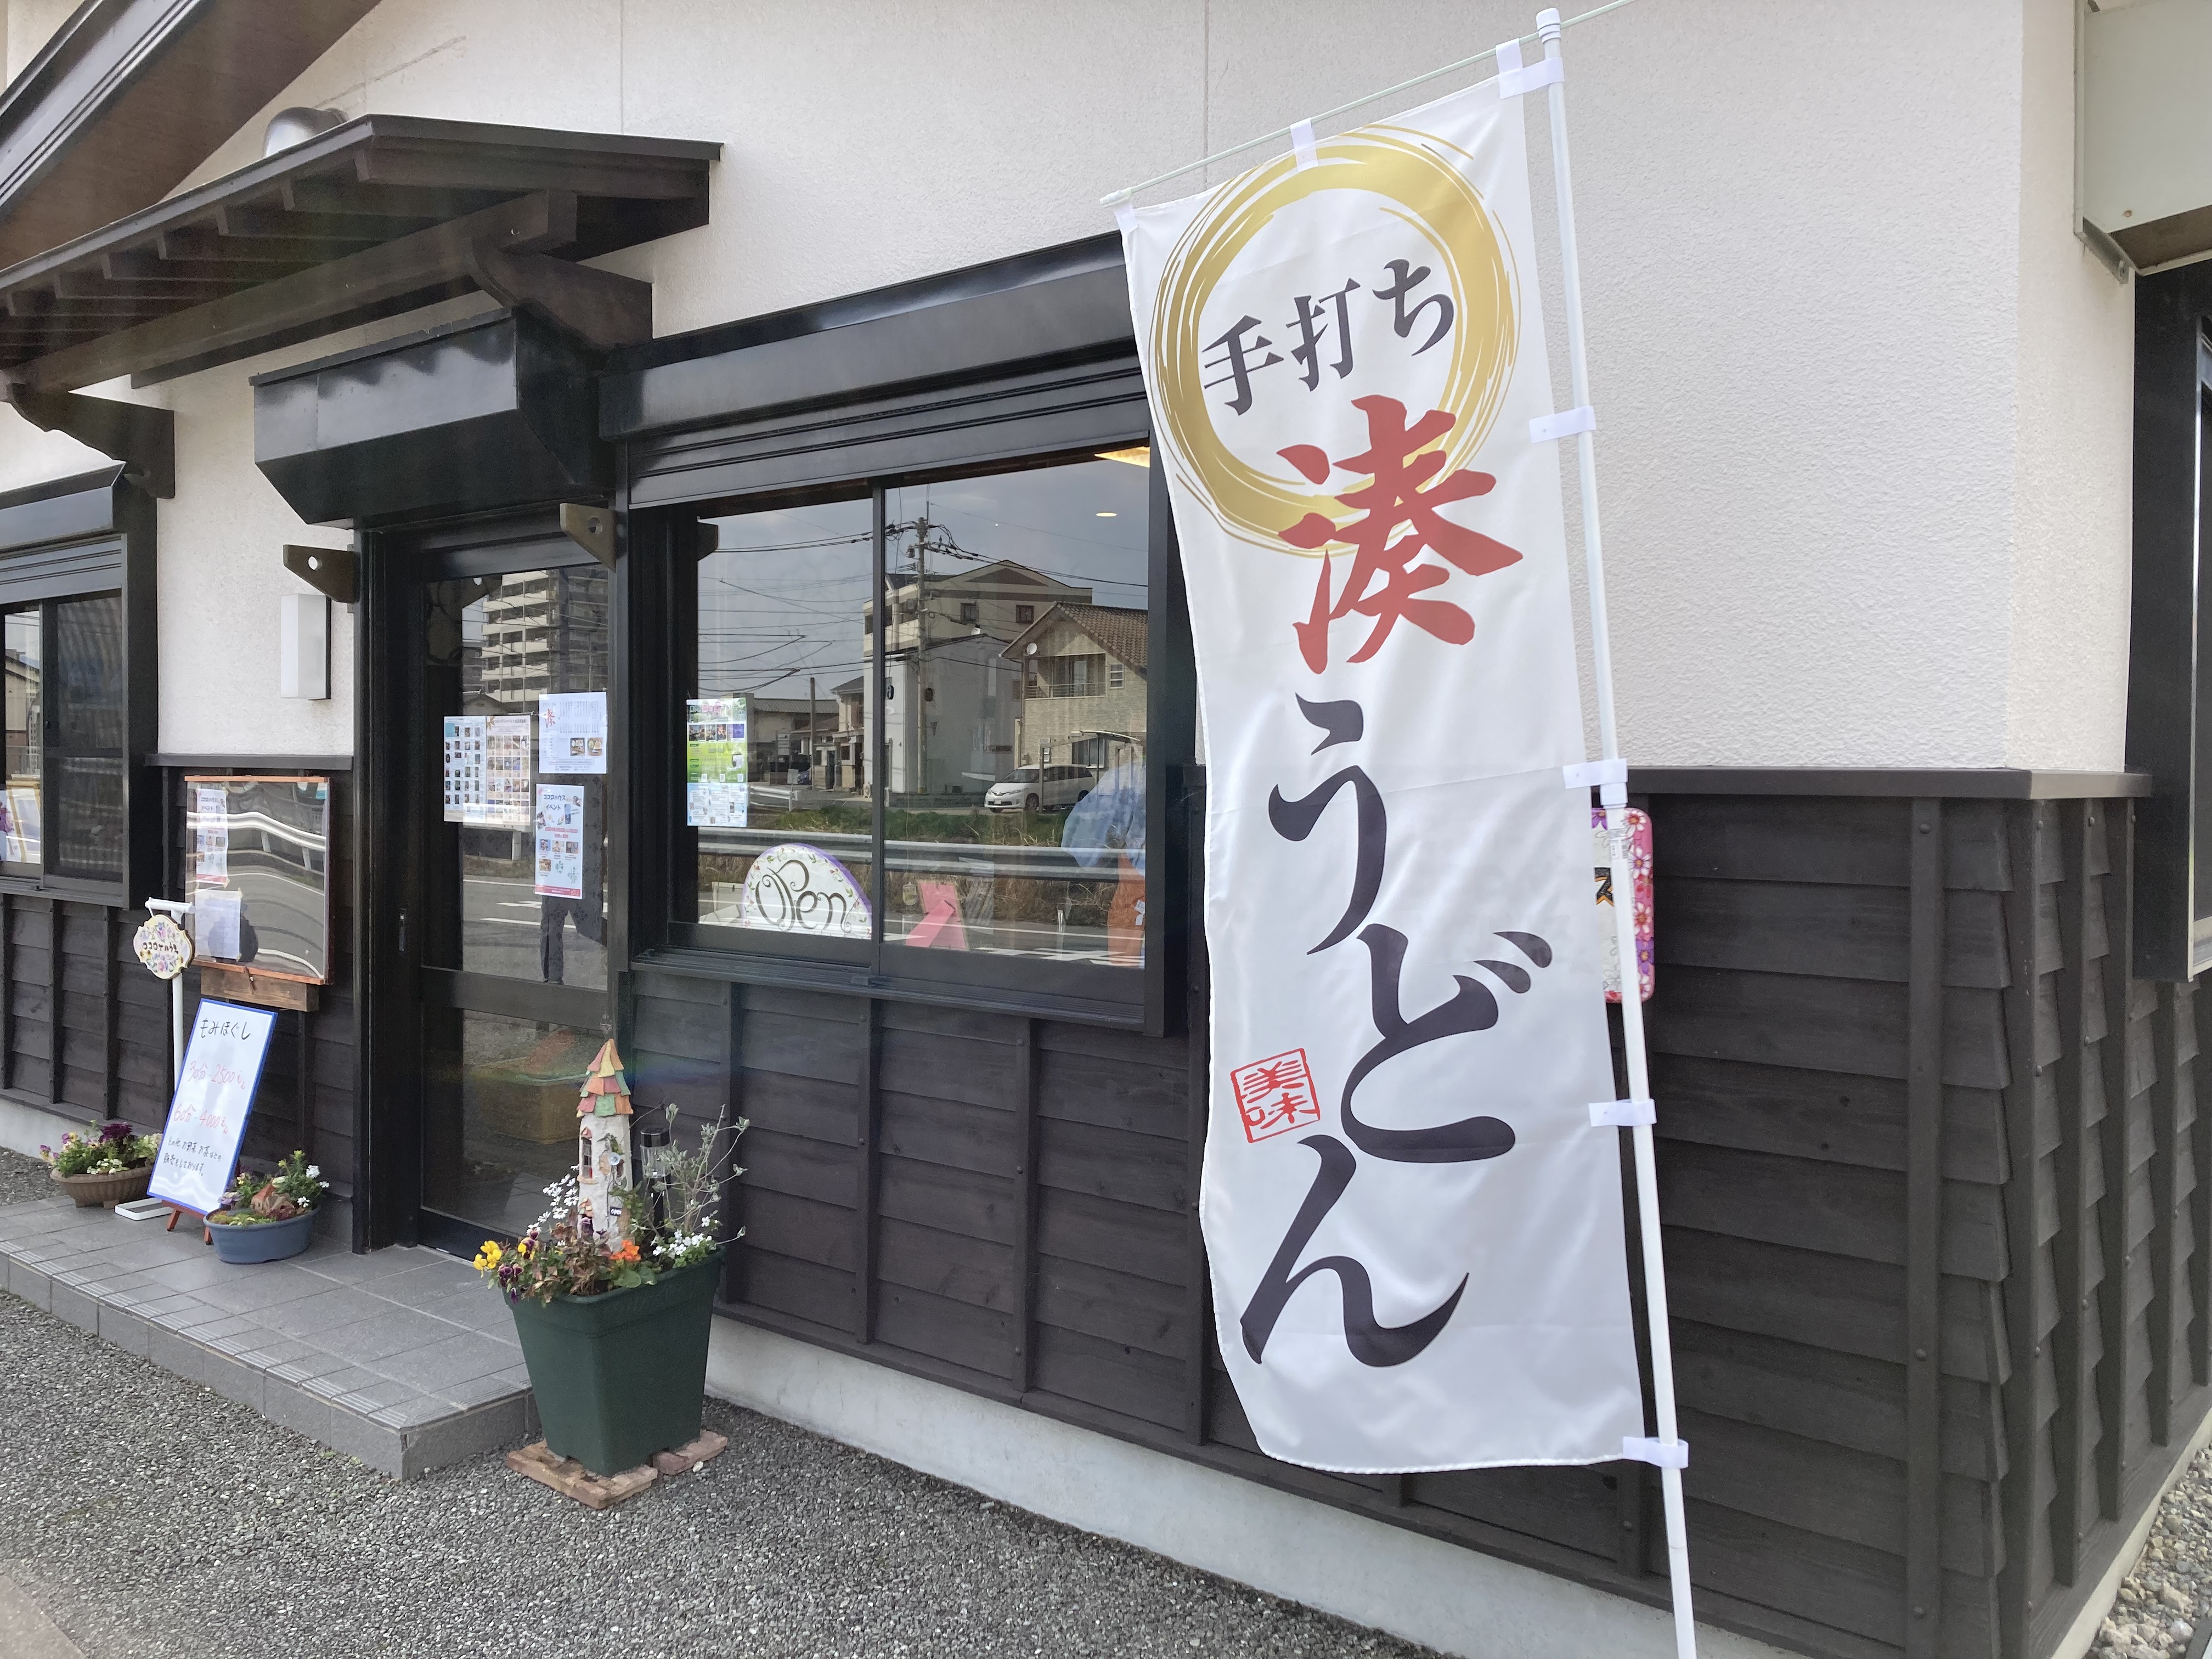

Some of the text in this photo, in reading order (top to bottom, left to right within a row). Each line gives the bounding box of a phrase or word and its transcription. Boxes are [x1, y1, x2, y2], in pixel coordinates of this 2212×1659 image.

[1202, 258, 1455, 417] 手打ち
[200, 1017, 251, 1040] もみほぐし
[1242, 1058, 1319, 1136] 美味
